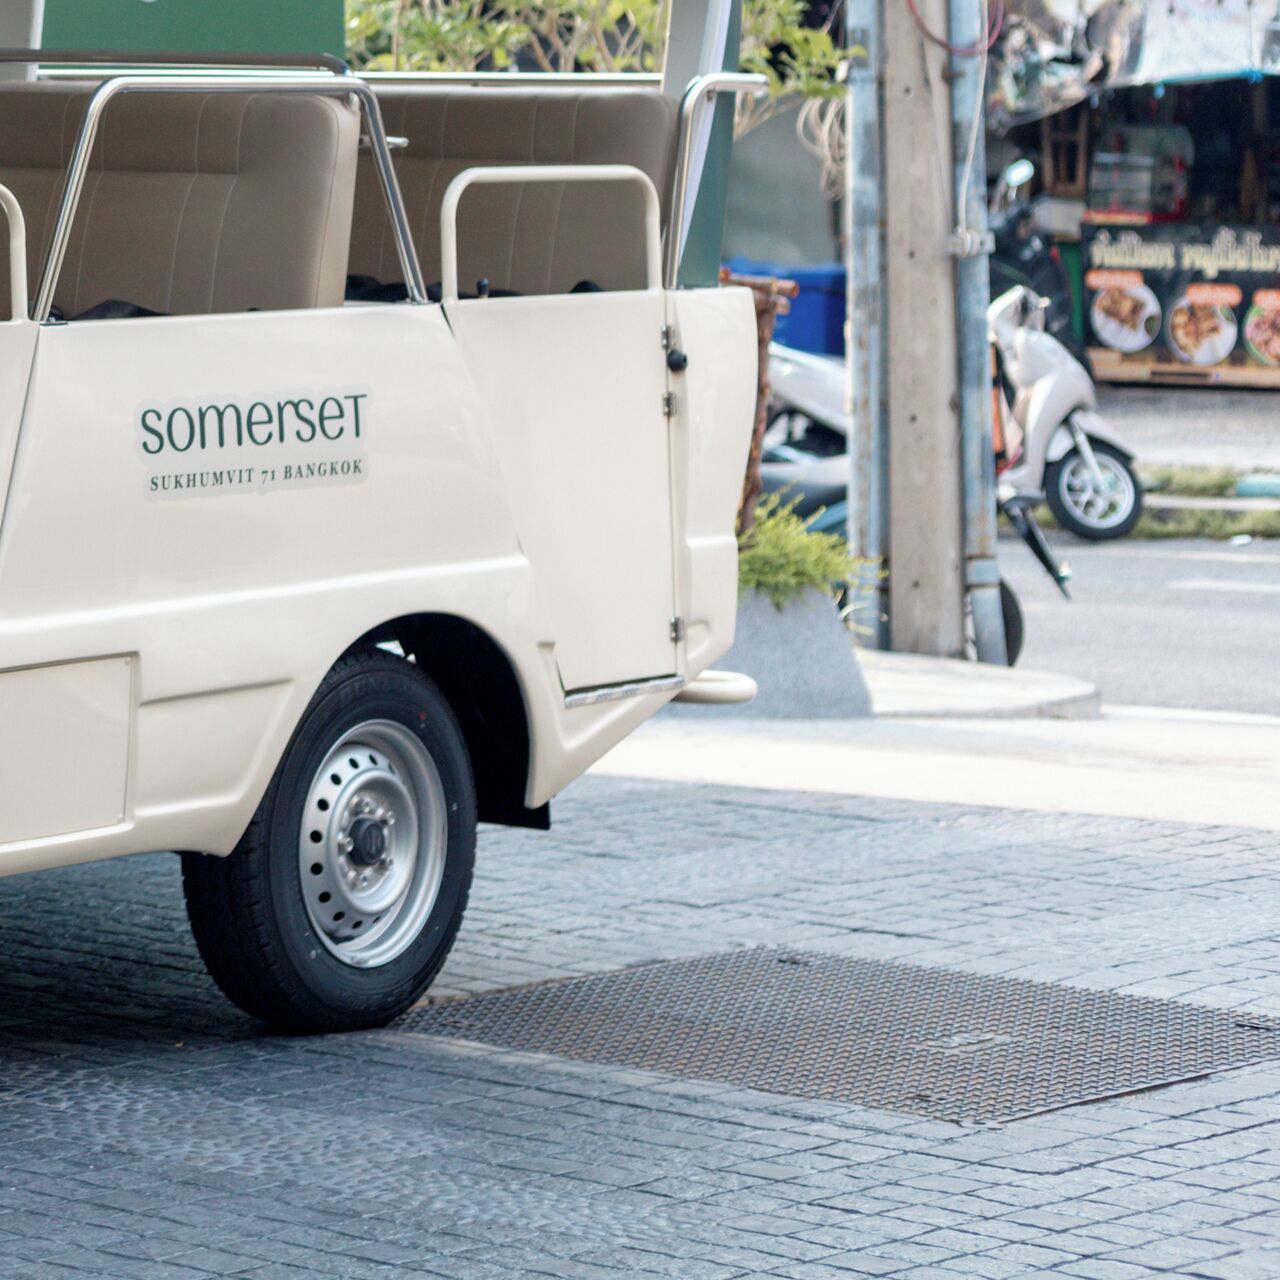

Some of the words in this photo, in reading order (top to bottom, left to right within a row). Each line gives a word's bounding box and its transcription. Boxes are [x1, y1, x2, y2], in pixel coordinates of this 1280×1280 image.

[150, 468, 255, 492] SUKHUMVIT
[261, 470, 276, 484] 71
[283, 459, 363, 480] BANGKOK
